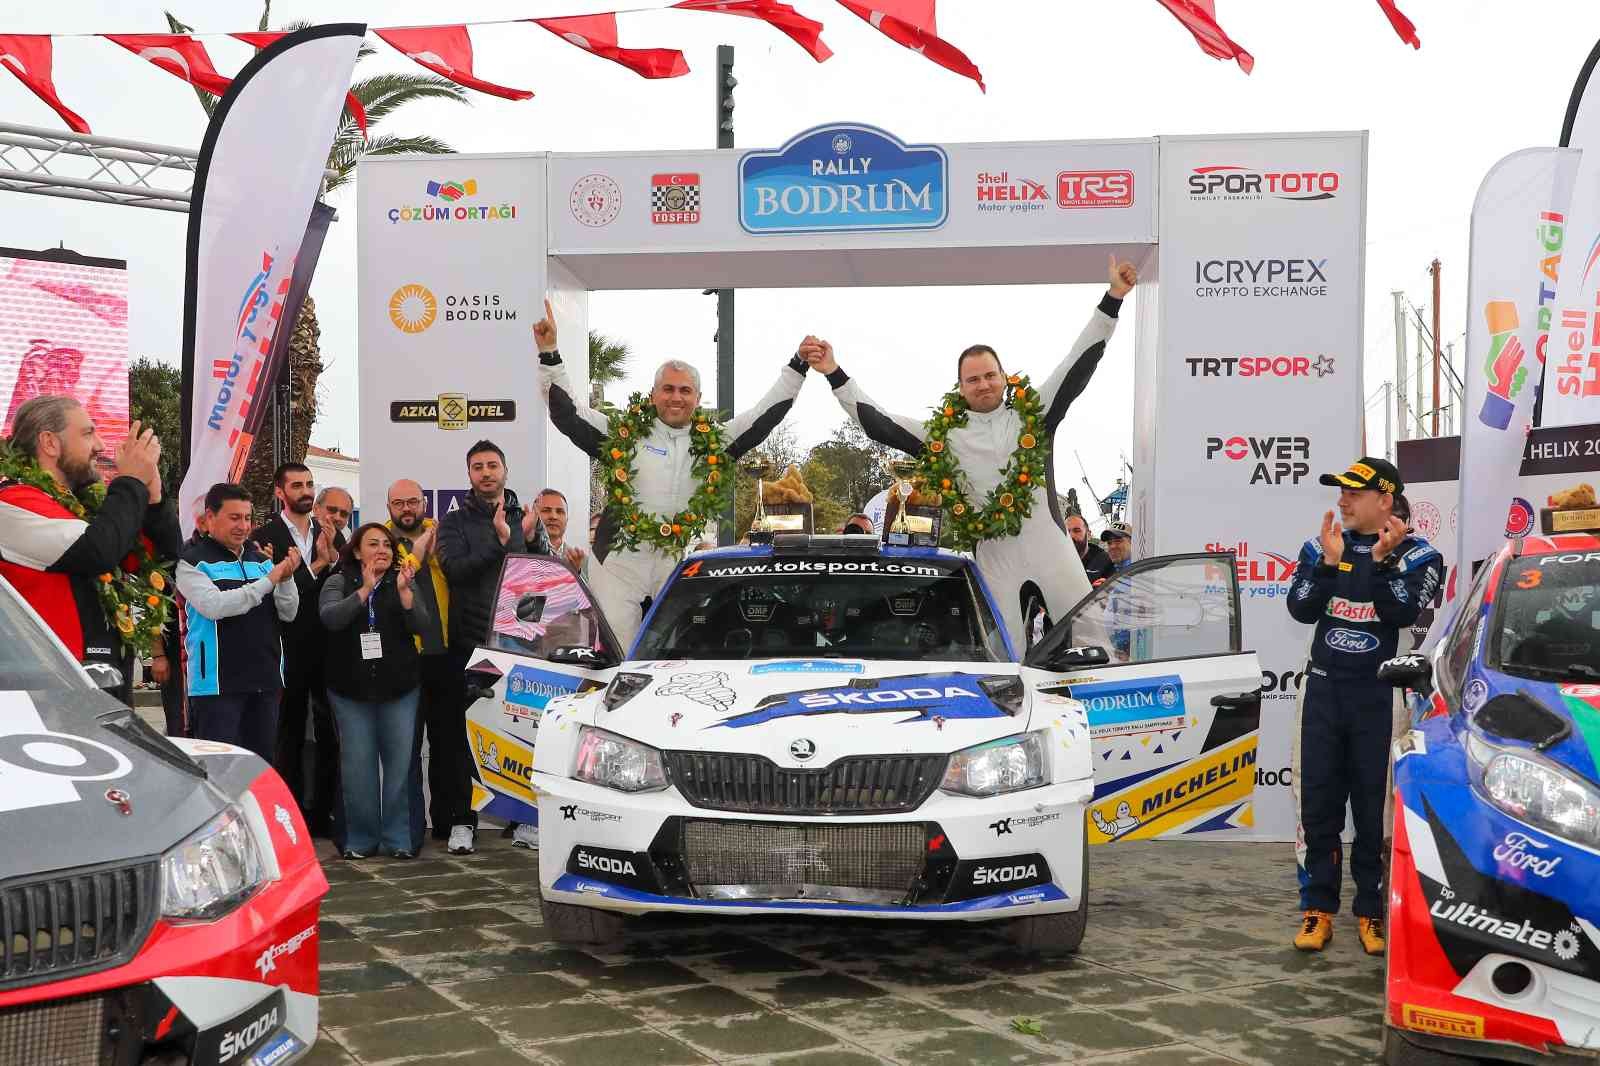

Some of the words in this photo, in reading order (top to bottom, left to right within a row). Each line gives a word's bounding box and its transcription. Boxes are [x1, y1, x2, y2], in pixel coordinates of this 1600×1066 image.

[812, 157, 872, 177] RALLY
[977, 171, 1008, 184] Shell
[755, 179, 933, 216] BODRUM
[977, 183, 1050, 201] HELIX
[1061, 174, 1130, 199] TRS
[388, 204, 450, 224] ÇÖZÜM
[454, 201, 517, 221] ORTAĞI
[654, 212, 698, 223] TOSFED
[977, 203, 1007, 212] Motor
[1195, 258, 1329, 284] ICRYPEX
[446, 295, 500, 306] OASIS
[1195, 286, 1250, 298] CRYPTO
[1253, 285, 1329, 297] EXCHANGE
[446, 309, 517, 321] BODRUM
[1557, 308, 1588, 399] Shell
[399, 405, 438, 417] AZKA
[468, 404, 505, 417] OTEL
[1206, 436, 1311, 461] POWER
[1531, 440, 1580, 461] HELIX
[1249, 462, 1310, 485] APP
[681, 560, 704, 578] 4
[708, 560, 940, 577] www.toksport.com
[1515, 568, 1544, 590] 3
[1330, 630, 1370, 651] Ford
[798, 686, 981, 709] ŠKODA
[1079, 690, 1156, 714] BODRUM
[502, 756, 534, 782] MIC
[1141, 747, 1257, 816] MICHELIN
[577, 849, 637, 877] ŠKODA
[1493, 832, 1562, 878] Ford
[972, 863, 1038, 886] ŠKODA
[1440, 886, 1456, 900] bp
[1430, 899, 1553, 950] ultimate
[1569, 921, 1582, 933] bp
[1409, 1008, 1477, 1035] PIRELLI
[218, 1006, 278, 1064] ŠKODA
